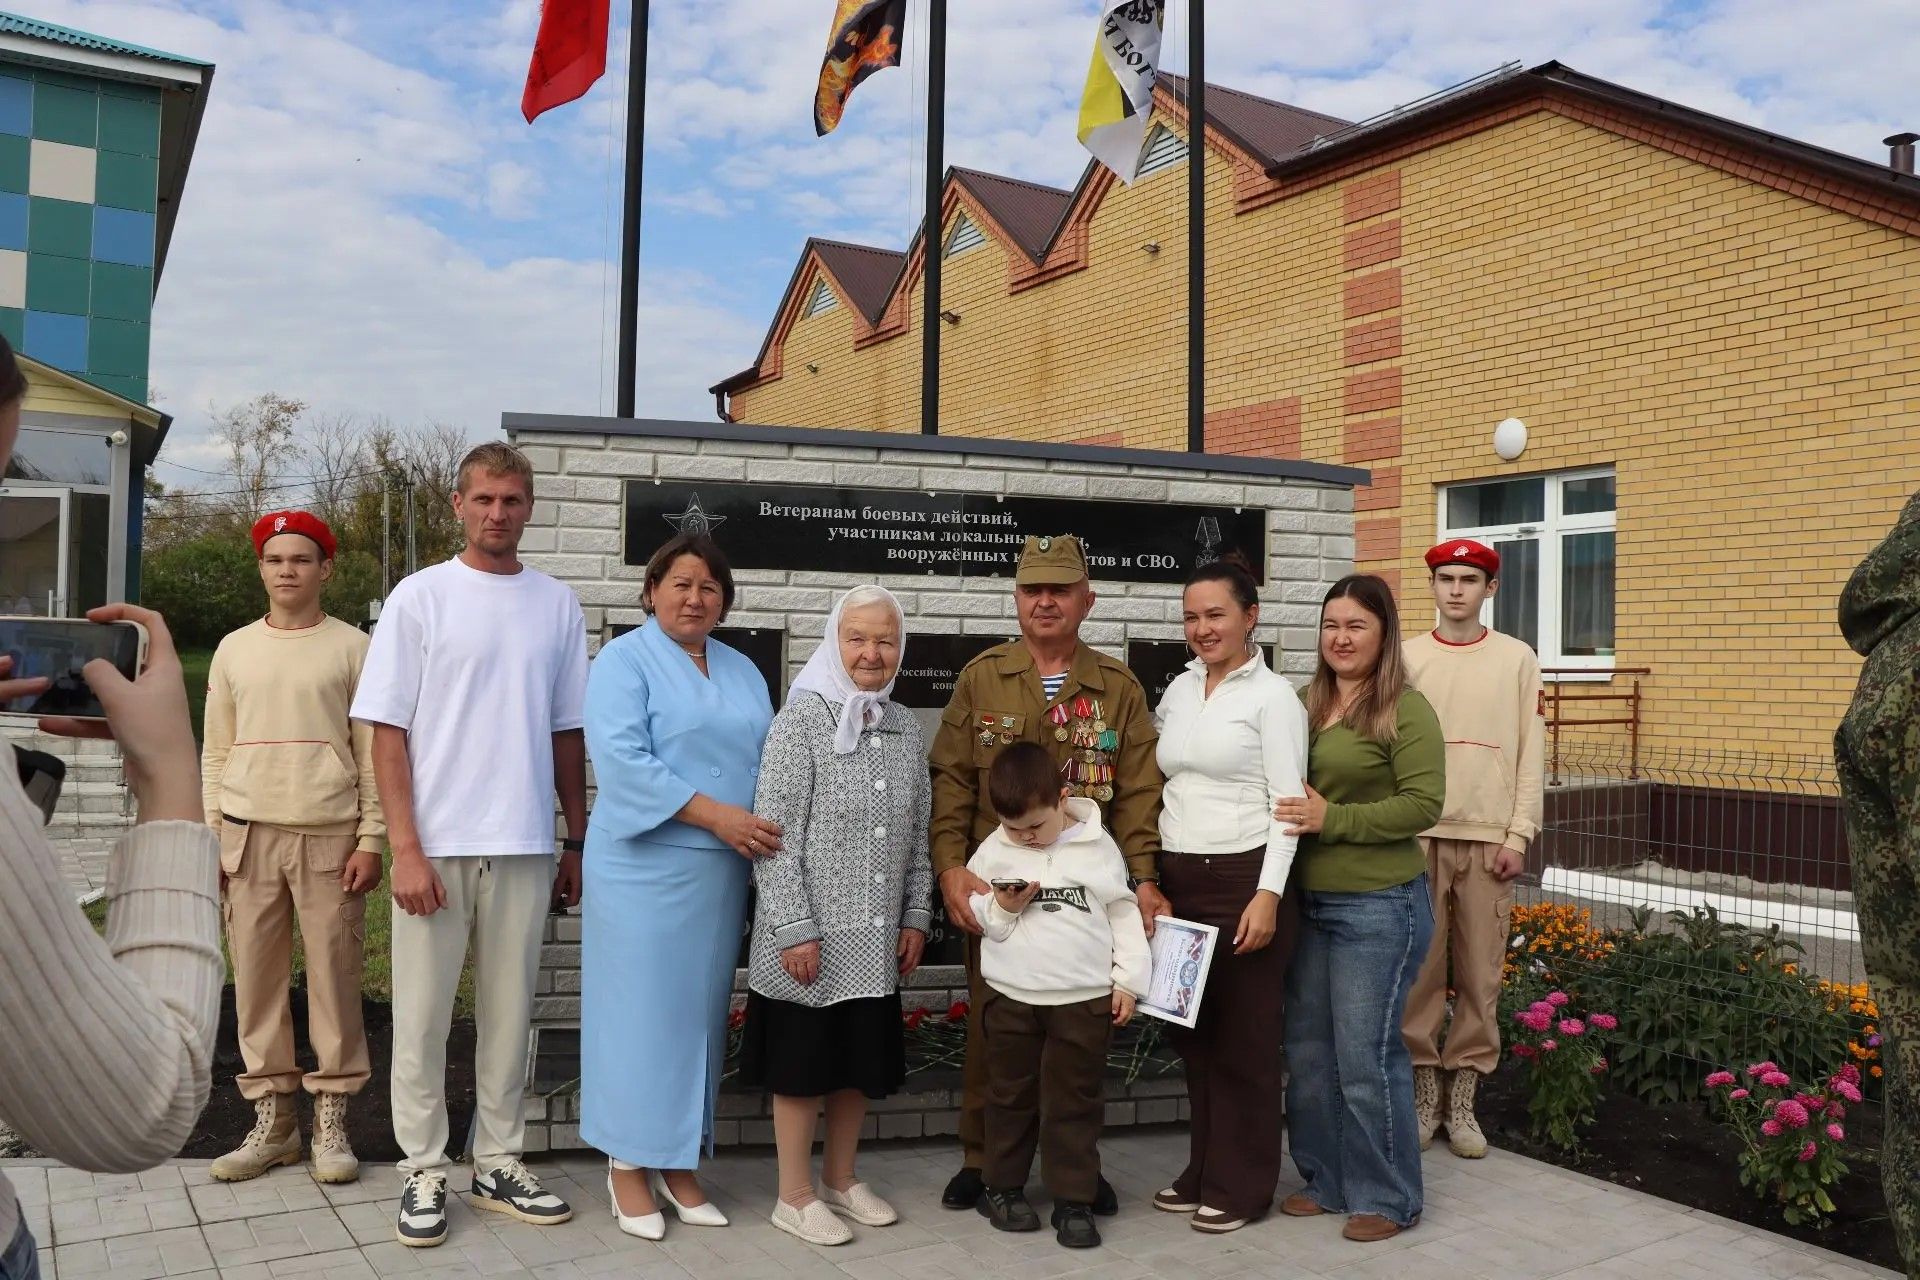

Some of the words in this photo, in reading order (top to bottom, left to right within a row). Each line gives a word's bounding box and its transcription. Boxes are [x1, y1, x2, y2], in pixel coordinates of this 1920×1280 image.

[1113, 37, 1156, 86] БОГ
[759, 501, 857, 521] Ветеранам
[862, 506, 926, 522] боевых
[931, 510, 1018, 528] действий,
[828, 526, 936, 541] участникам
[940, 530, 1036, 545] локальны
[887, 548, 1008, 564] вооружённых
[1121, 557, 1131, 567] и
[1136, 554, 1180, 569] СВО.
